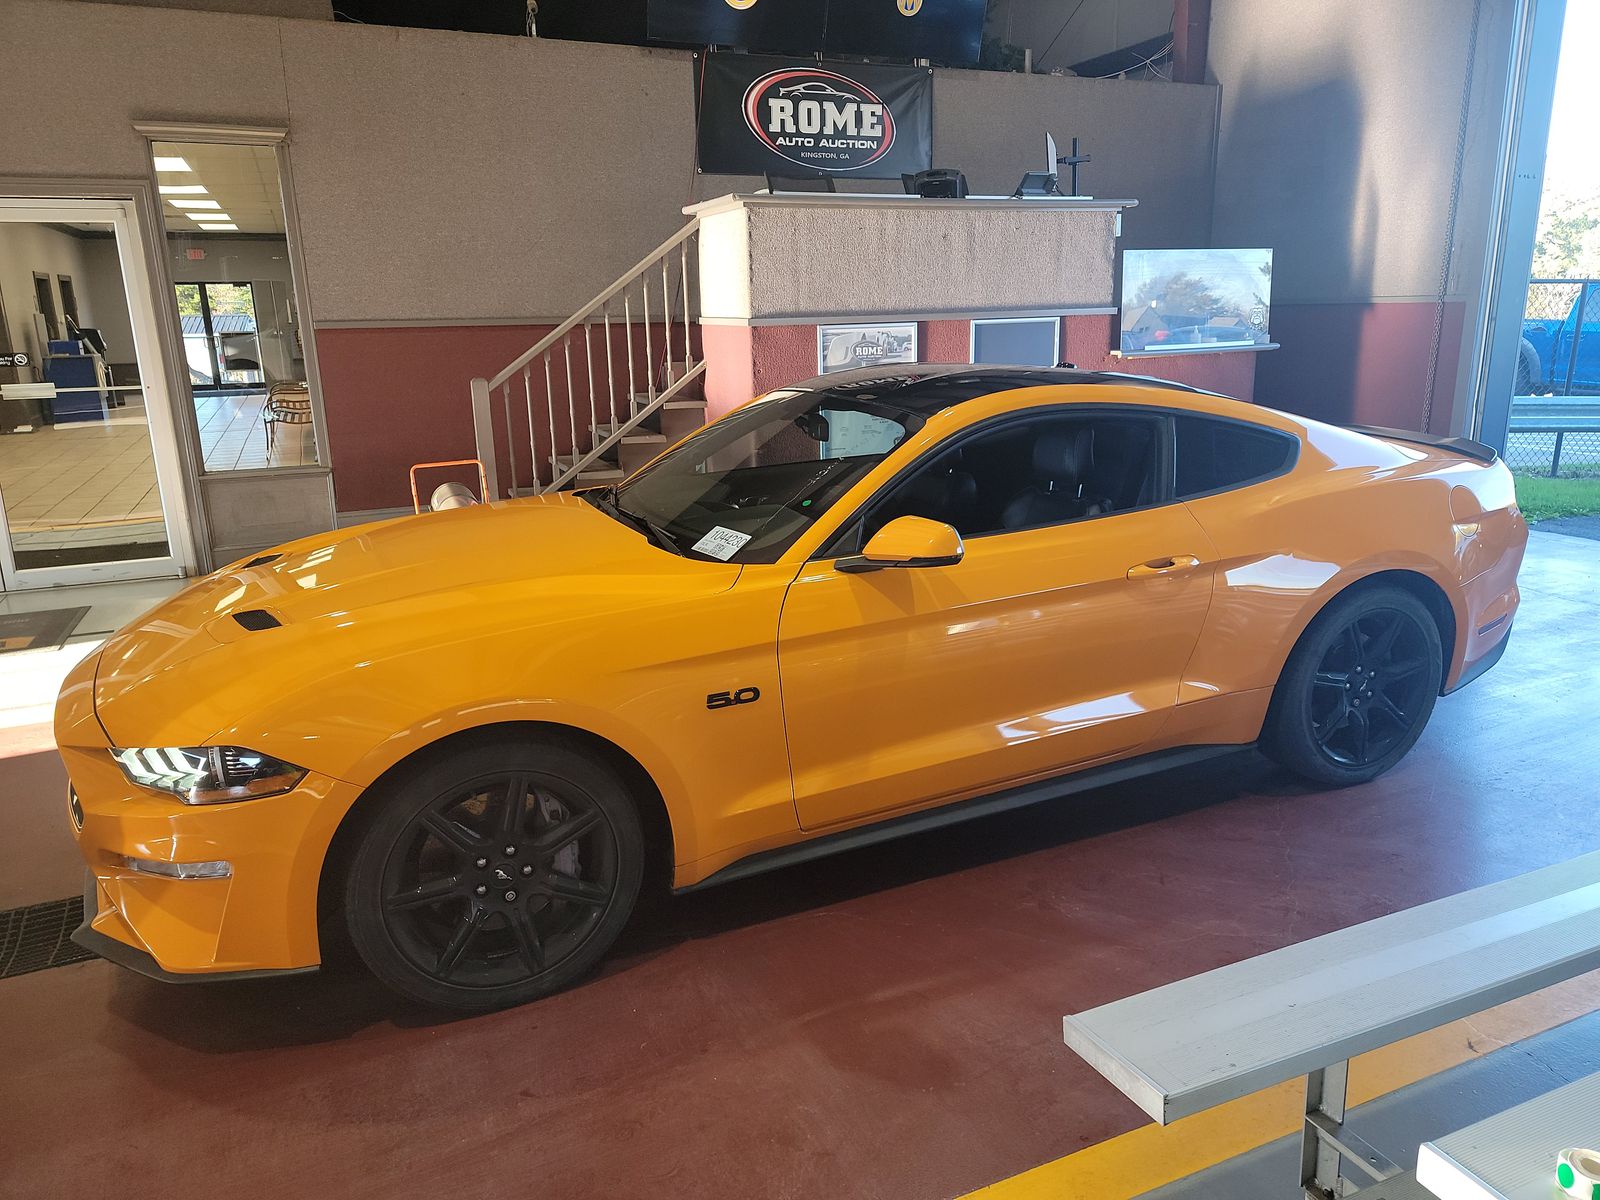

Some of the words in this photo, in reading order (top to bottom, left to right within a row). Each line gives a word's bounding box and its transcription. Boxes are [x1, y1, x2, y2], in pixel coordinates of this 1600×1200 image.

[768, 98, 883, 136] ROME
[775, 136, 815, 147] AUTO
[819, 138, 878, 149] AUCTION
[800, 151, 838, 160] KINGSTON,
[855, 346, 883, 356] ROME
[710, 530, 748, 549] 1044230
[706, 686, 761, 710] 5.0
